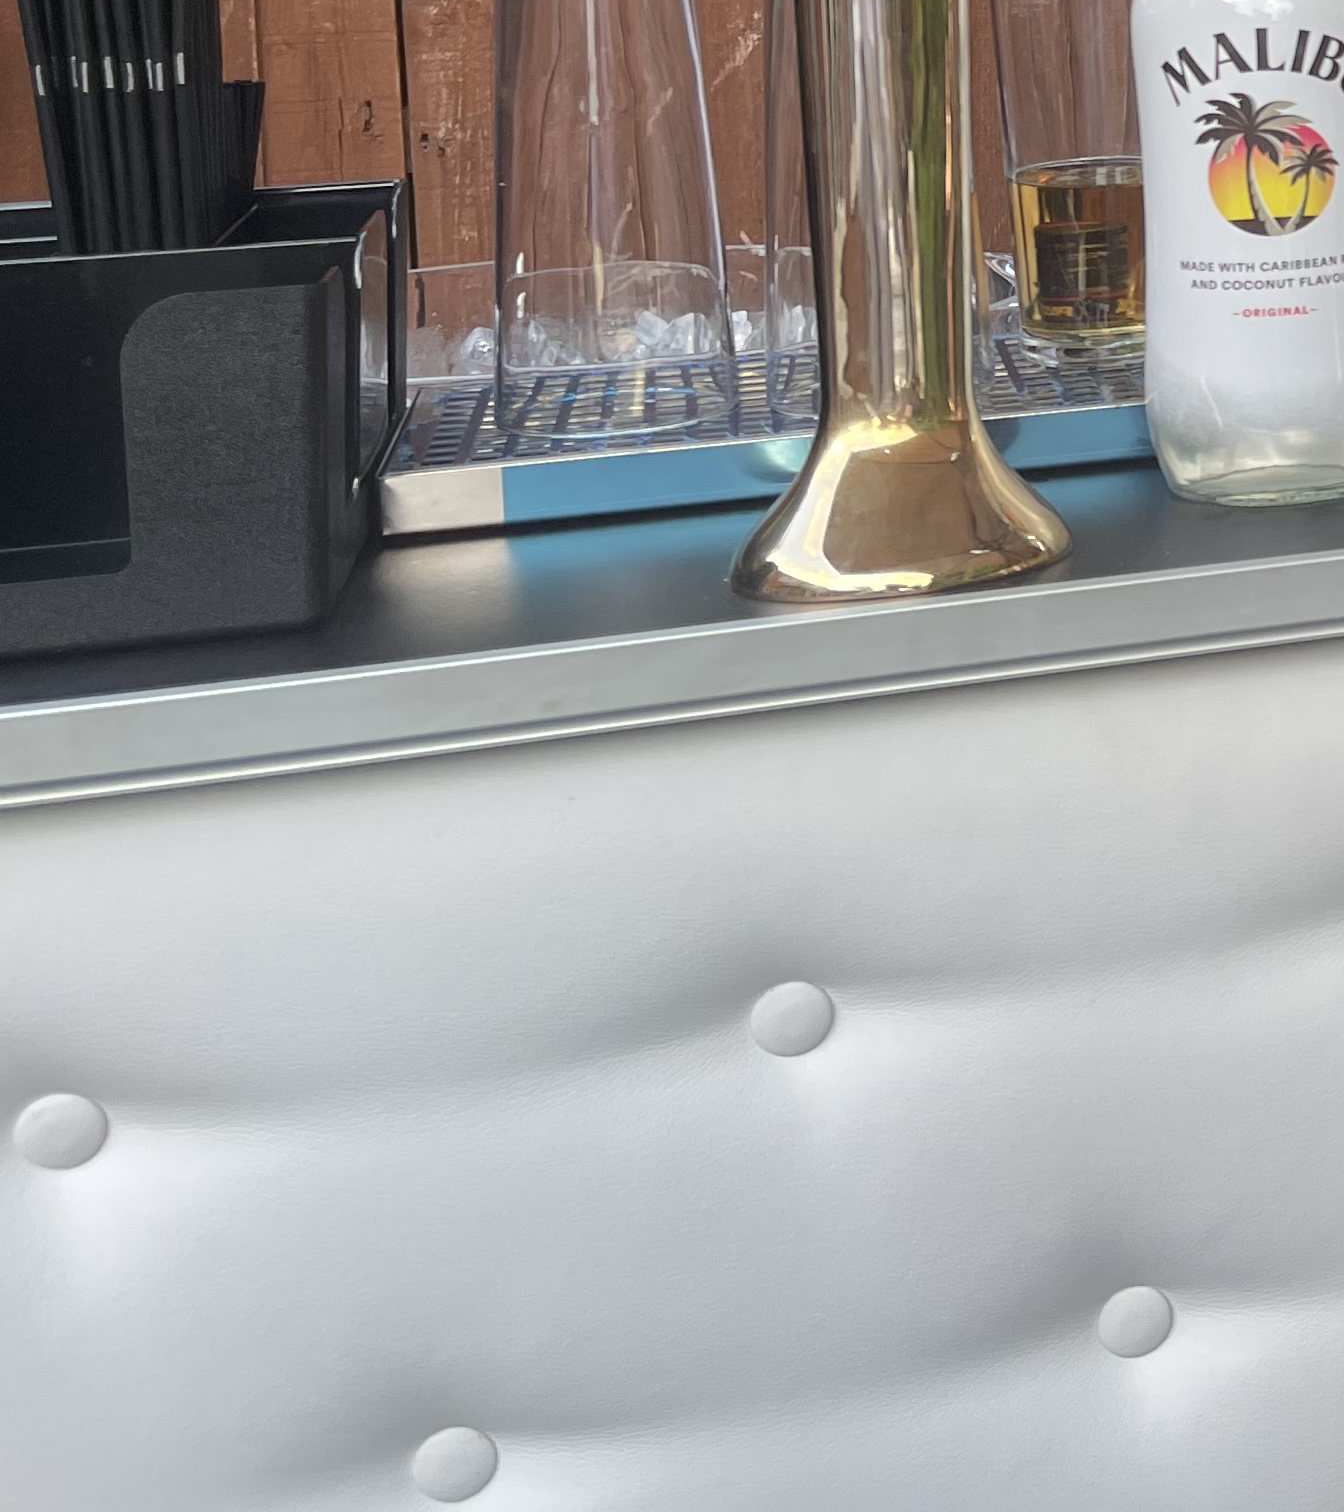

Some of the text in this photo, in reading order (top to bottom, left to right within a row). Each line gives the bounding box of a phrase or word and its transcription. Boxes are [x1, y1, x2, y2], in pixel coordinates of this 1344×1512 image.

[1180, 260, 1215, 273] MADE
[1218, 261, 1256, 273] WITH
[1259, 255, 1338, 272] CARIBBEAN
[1191, 279, 1218, 290] AND
[1221, 278, 1295, 291] COCONUT
